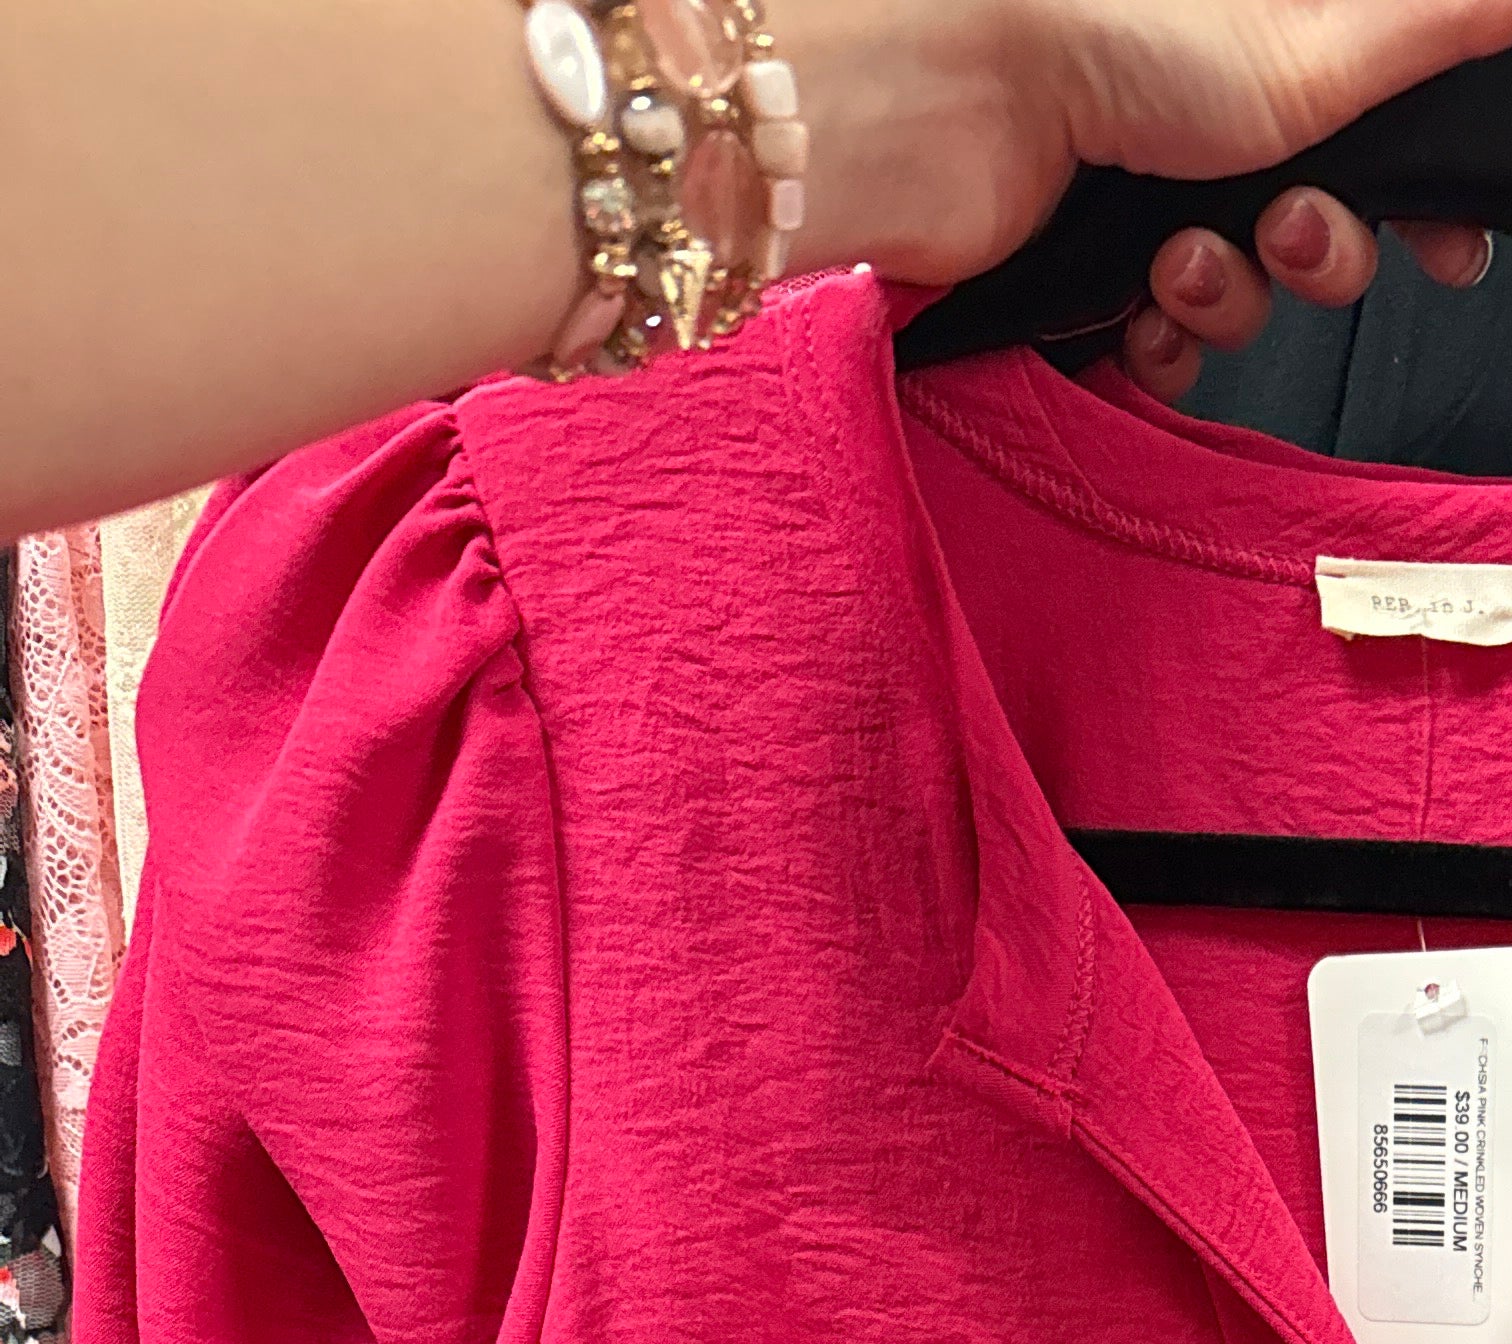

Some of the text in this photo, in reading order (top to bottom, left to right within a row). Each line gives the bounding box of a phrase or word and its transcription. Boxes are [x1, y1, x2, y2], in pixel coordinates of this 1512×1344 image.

[1477, 1038, 1489, 1094] FCHSIA
[1477, 1096, 1488, 1128] PINK
[1373, 1124, 1389, 1214] 85650666
[1453, 1090, 1470, 1252] $39.00 / MEDIUM
[1475, 1130, 1487, 1193] CRINKLED
[1474, 1195, 1485, 1240] WOVEN
